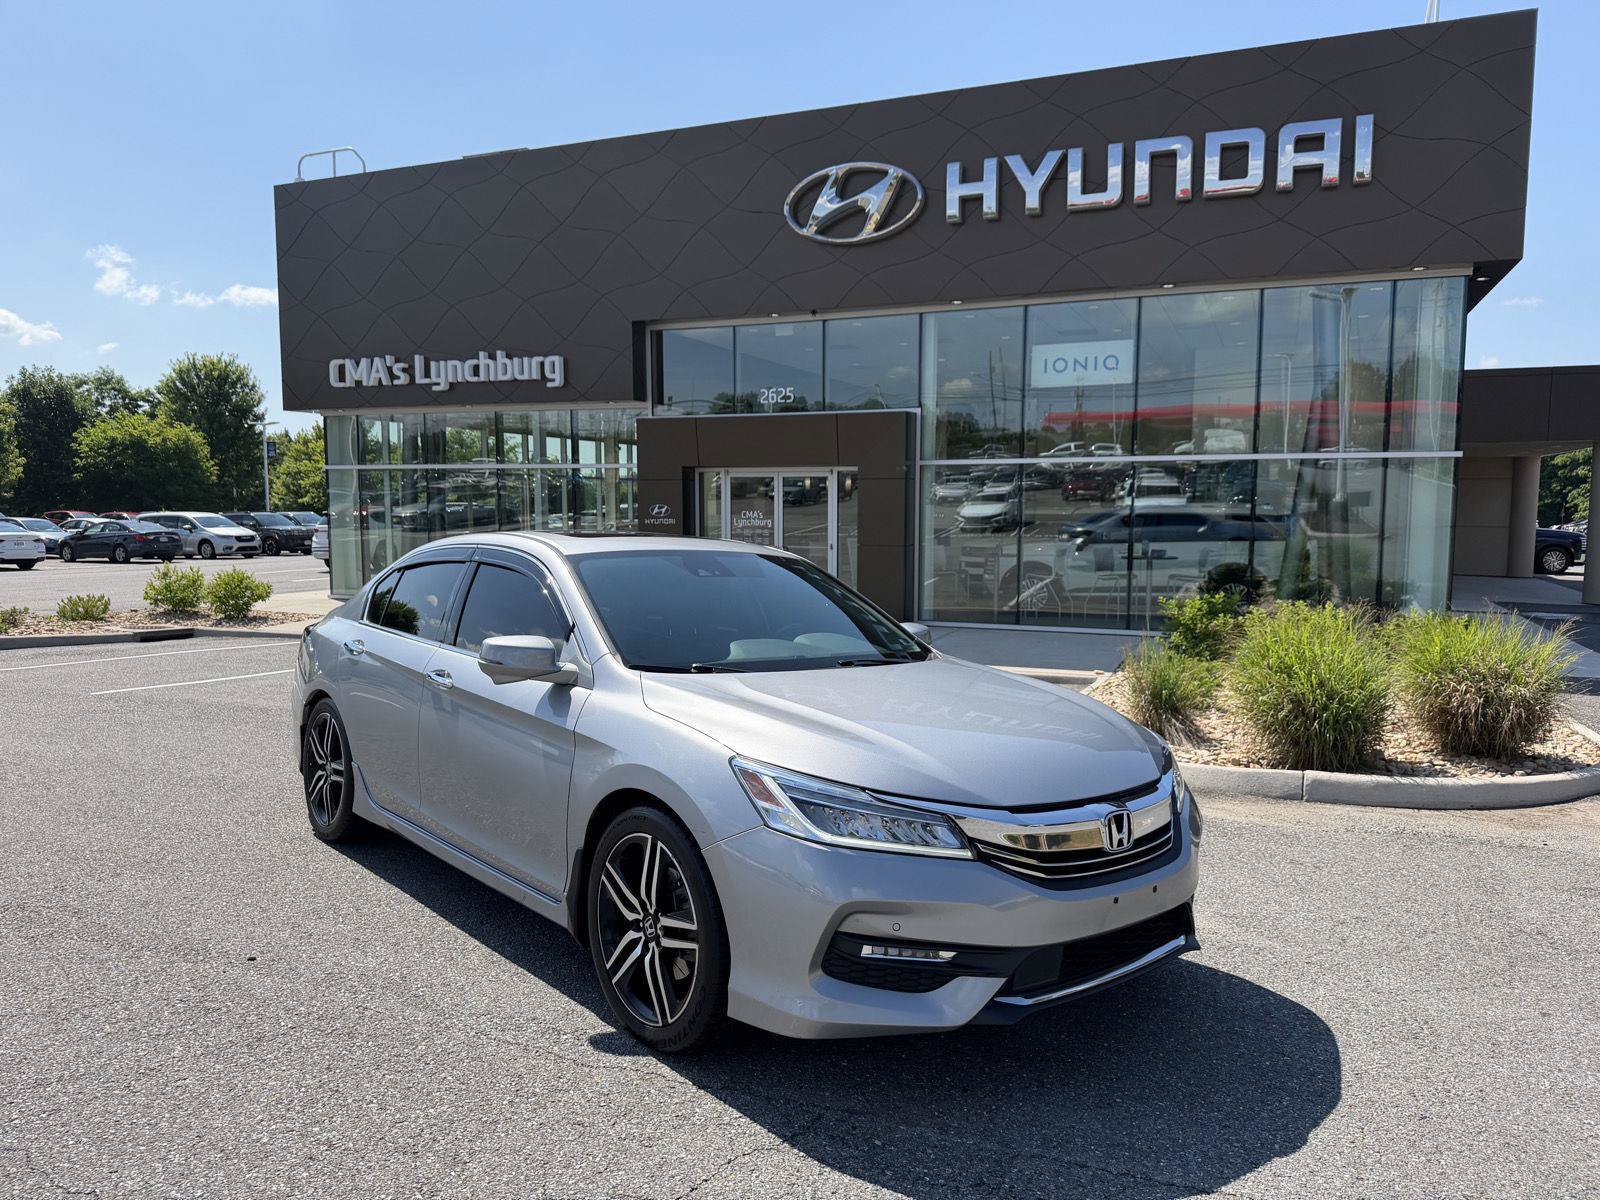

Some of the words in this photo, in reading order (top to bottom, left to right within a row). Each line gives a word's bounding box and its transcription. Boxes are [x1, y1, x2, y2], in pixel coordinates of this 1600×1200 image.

[945, 113, 1375, 224] HYUNDAI
[329, 354, 411, 388] CMA's
[414, 350, 565, 392] Lynchburg
[1043, 354, 1120, 374] IONIQ
[760, 387, 794, 404] 2625
[734, 517, 772, 528] Lynchburg
[741, 510, 763, 519] CMA's
